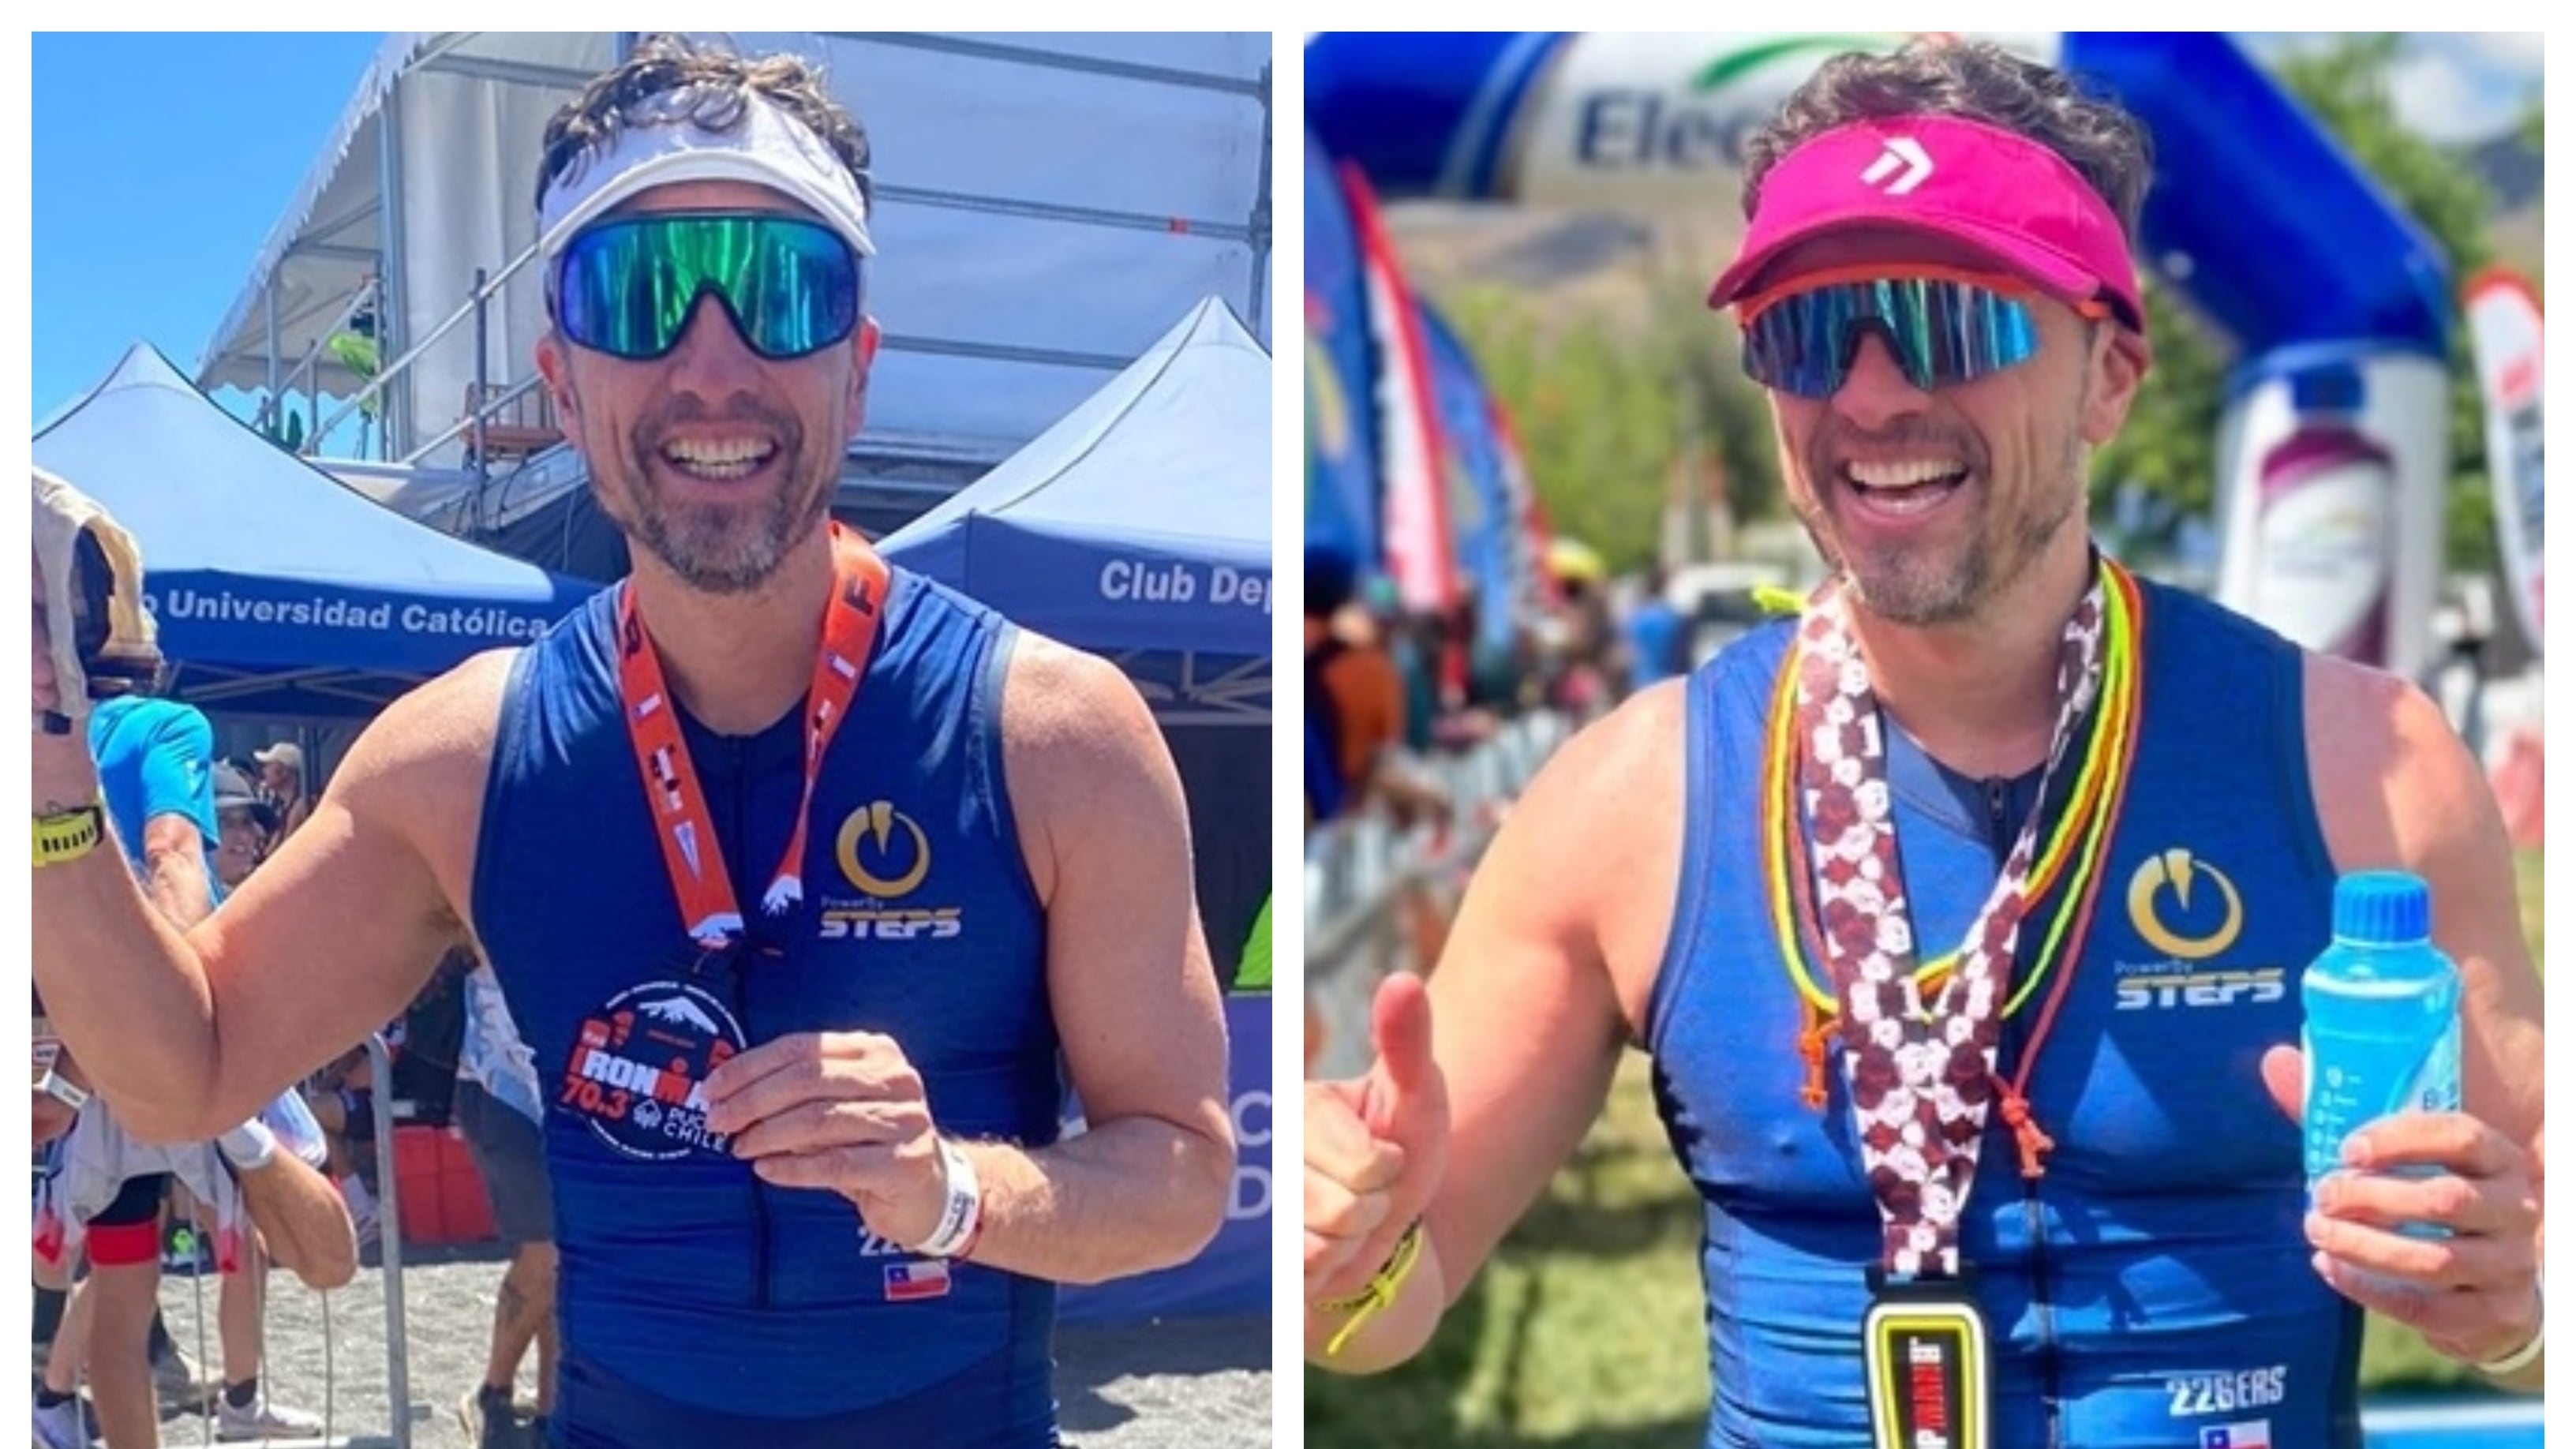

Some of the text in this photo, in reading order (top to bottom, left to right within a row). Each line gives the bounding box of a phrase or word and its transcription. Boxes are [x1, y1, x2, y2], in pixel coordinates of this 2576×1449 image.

[1100, 560, 1196, 602] Club
[167, 590, 391, 631] Universidad
[401, 603, 547, 639] Católica
[819, 908, 962, 938] STEPS
[2114, 967, 2286, 1011] STEPS
[561, 1073, 630, 1120] 70.3
[568, 1046, 711, 1112] IRONMA
[663, 1121, 728, 1153] CHILE
